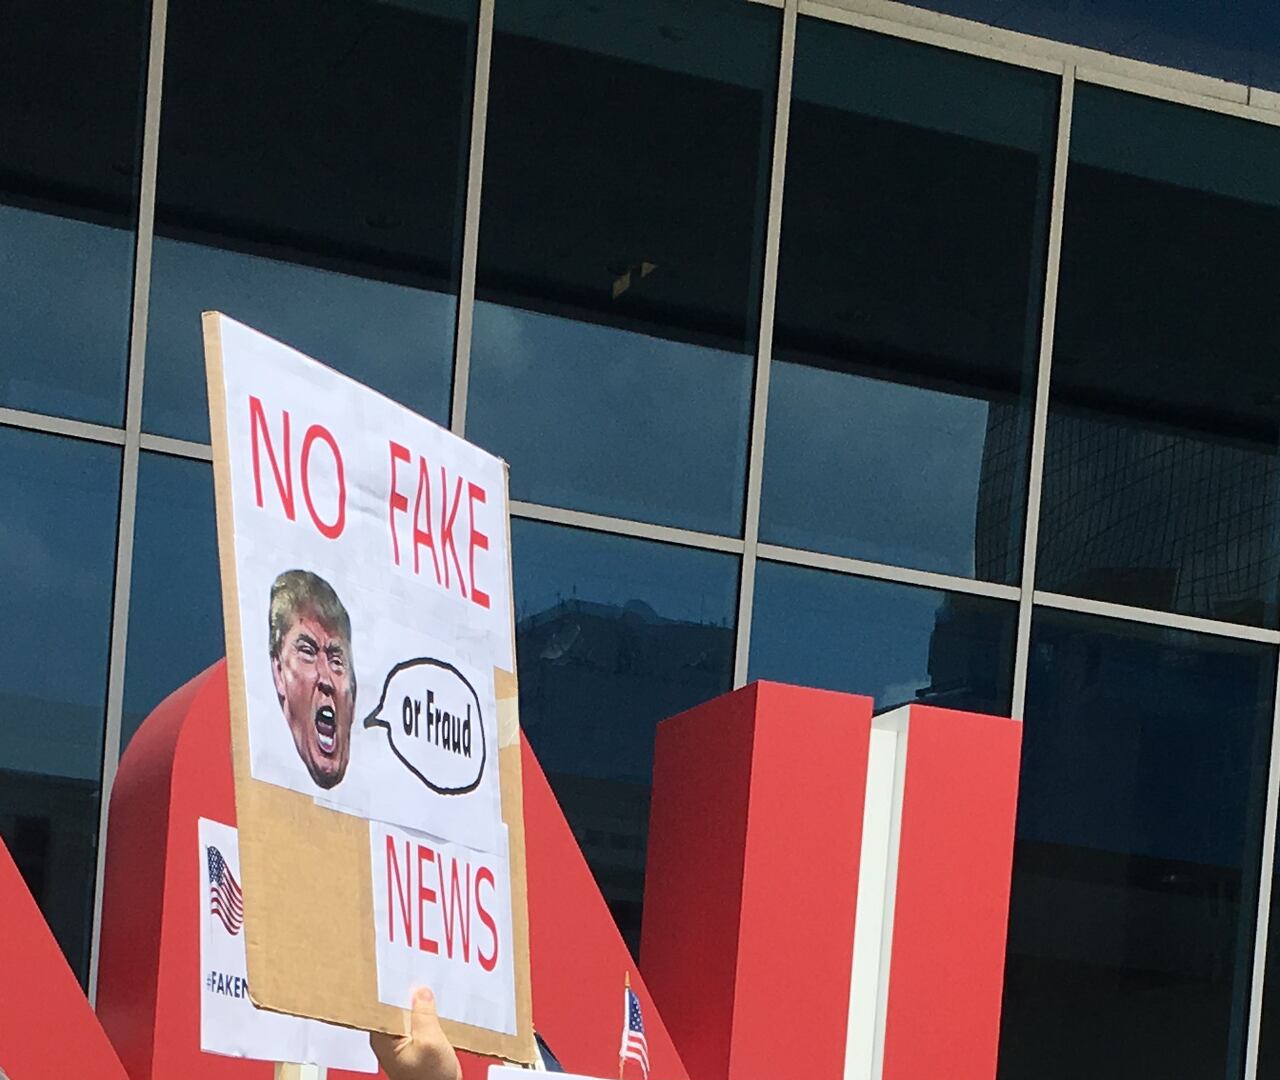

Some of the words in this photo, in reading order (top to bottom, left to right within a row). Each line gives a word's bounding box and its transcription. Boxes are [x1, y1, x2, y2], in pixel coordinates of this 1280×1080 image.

[249, 395, 346, 540] NO
[389, 440, 490, 609] FAKE
[402, 696, 421, 738] or
[426, 689, 471, 758] Fraud
[385, 834, 498, 972] NEWS
